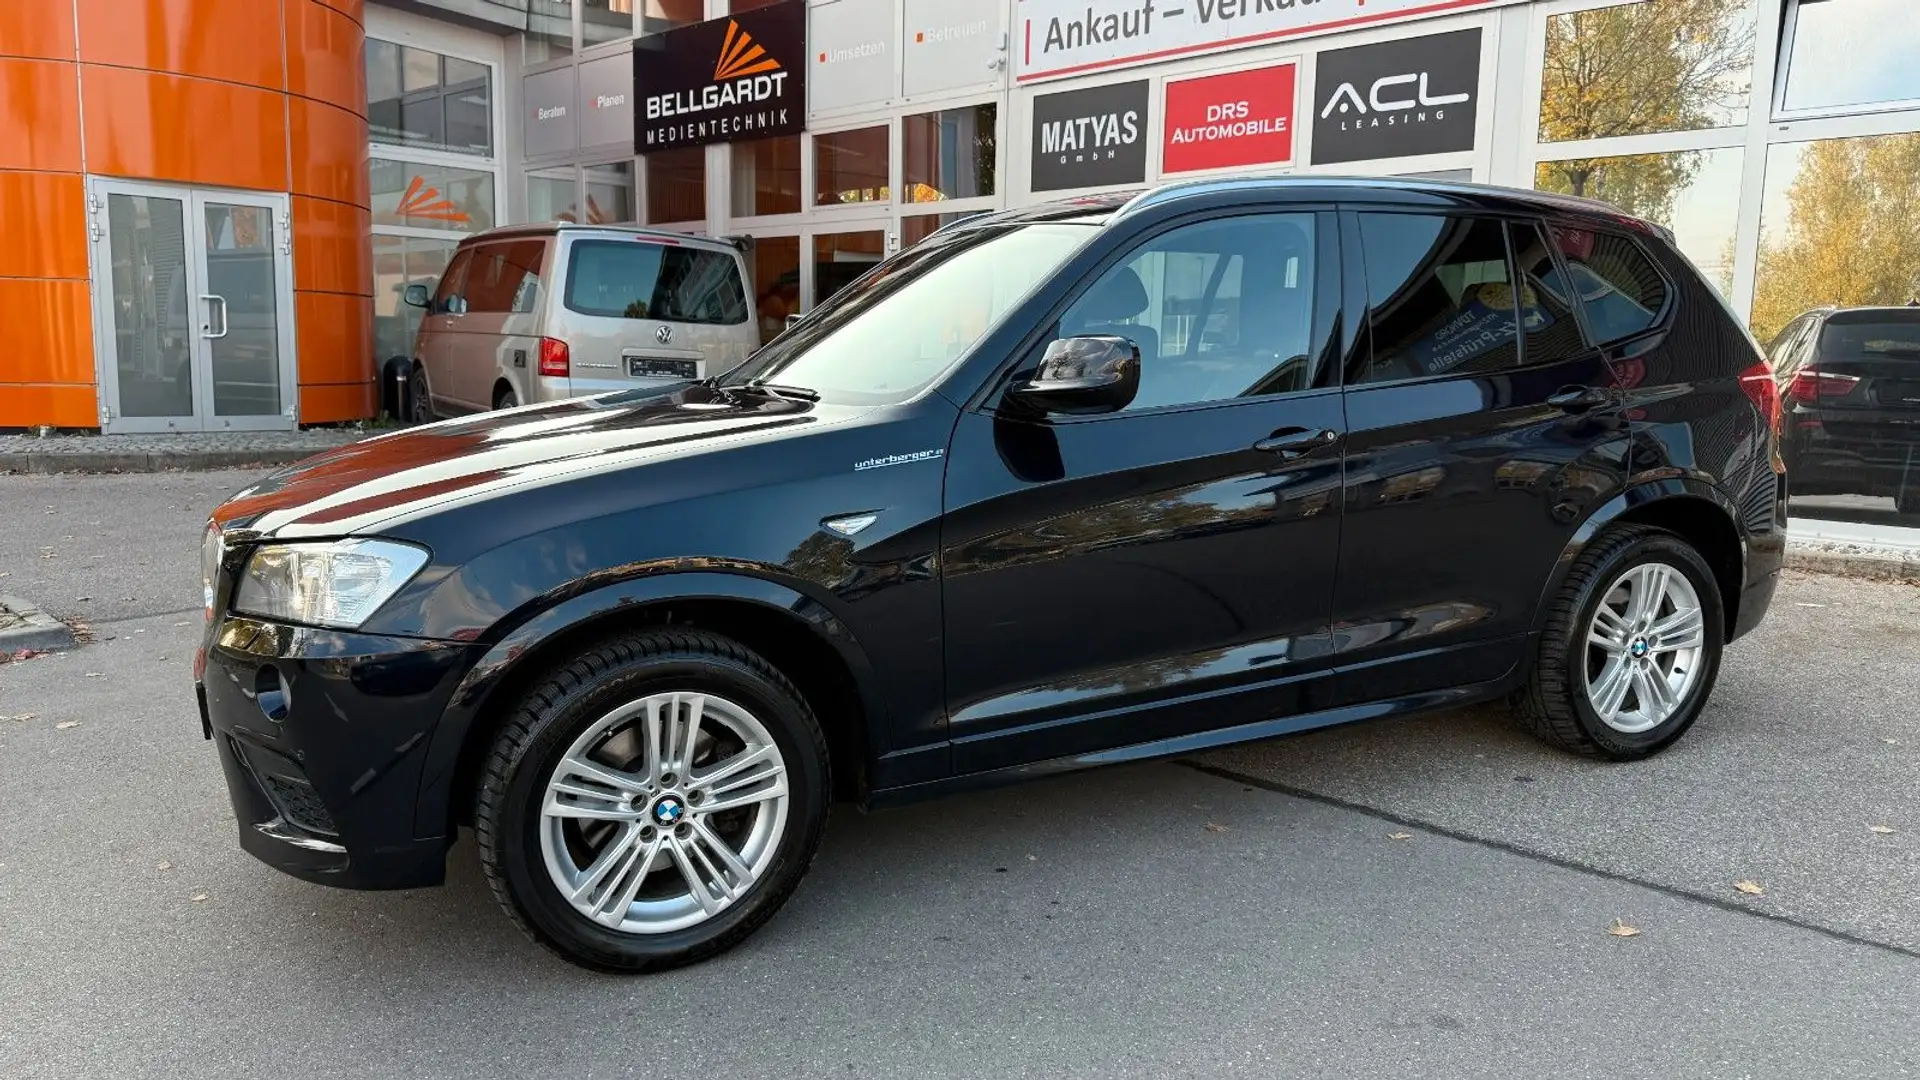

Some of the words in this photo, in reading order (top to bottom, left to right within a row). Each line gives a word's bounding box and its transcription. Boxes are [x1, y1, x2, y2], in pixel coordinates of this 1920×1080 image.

[927, 20, 986, 42] Betreuen
[1043, 0, 1154, 53] Ankauf
[829, 40, 885, 63] Umsetzen
[597, 94, 625, 108] Planen
[647, 72, 788, 119] BELLGARDT
[1321, 72, 1470, 119] ACL
[538, 106, 566, 120] Beraten
[1207, 101, 1249, 122] DRS
[1341, 110, 1444, 131] LEASING
[647, 109, 788, 144] MEDIENTECHNIK
[1041, 110, 1138, 154] MATYAS
[1171, 117, 1287, 144] AUTOMOBILE
[1060, 150, 1115, 164] GmbH
[854, 449, 934, 469] unterberger
